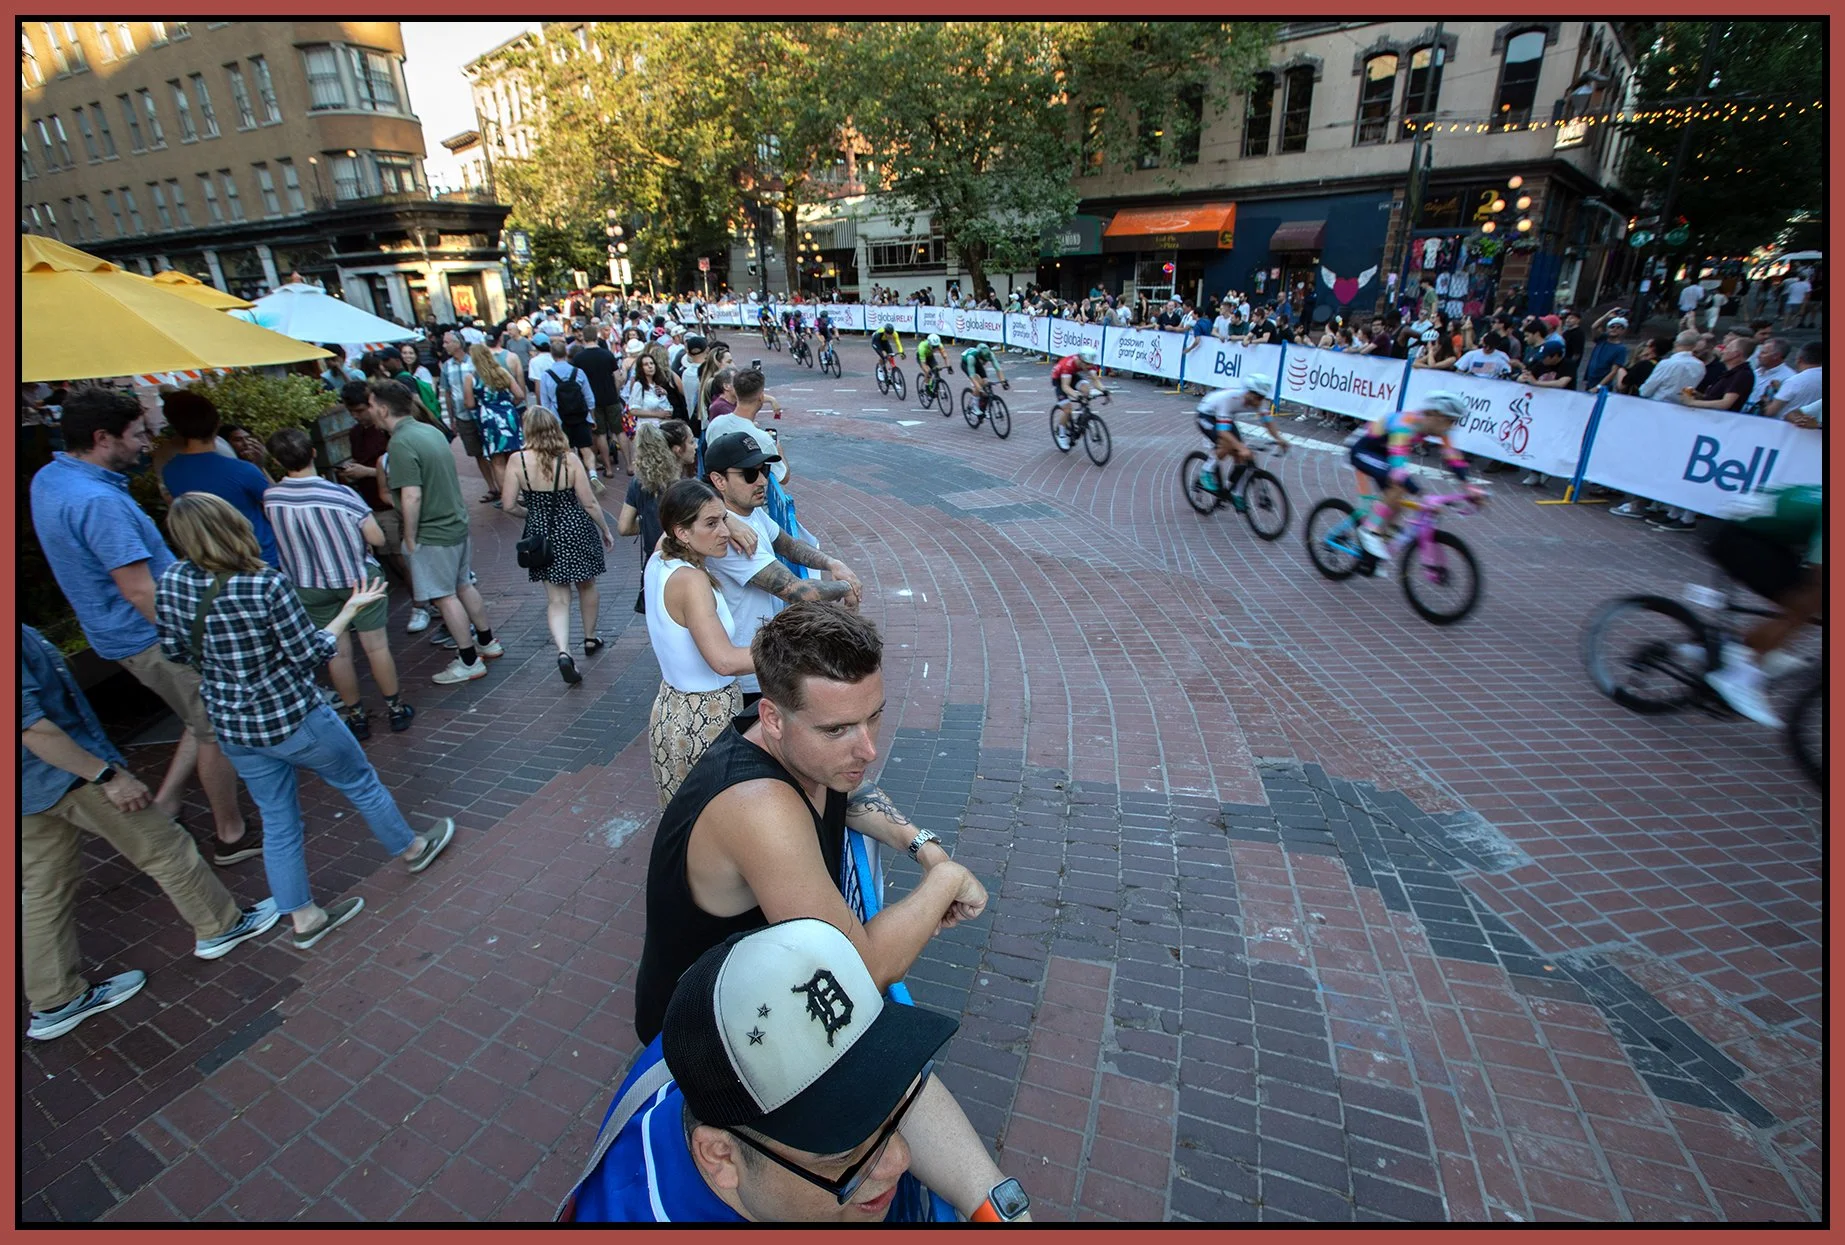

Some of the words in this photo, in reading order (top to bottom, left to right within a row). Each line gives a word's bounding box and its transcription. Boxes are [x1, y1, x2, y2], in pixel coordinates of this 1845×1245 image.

[1214, 350, 1242, 378] Bell
[1309, 365, 1396, 401] globalRELAY
[1468, 416, 1498, 434] prix
[1682, 434, 1780, 495] Bell
